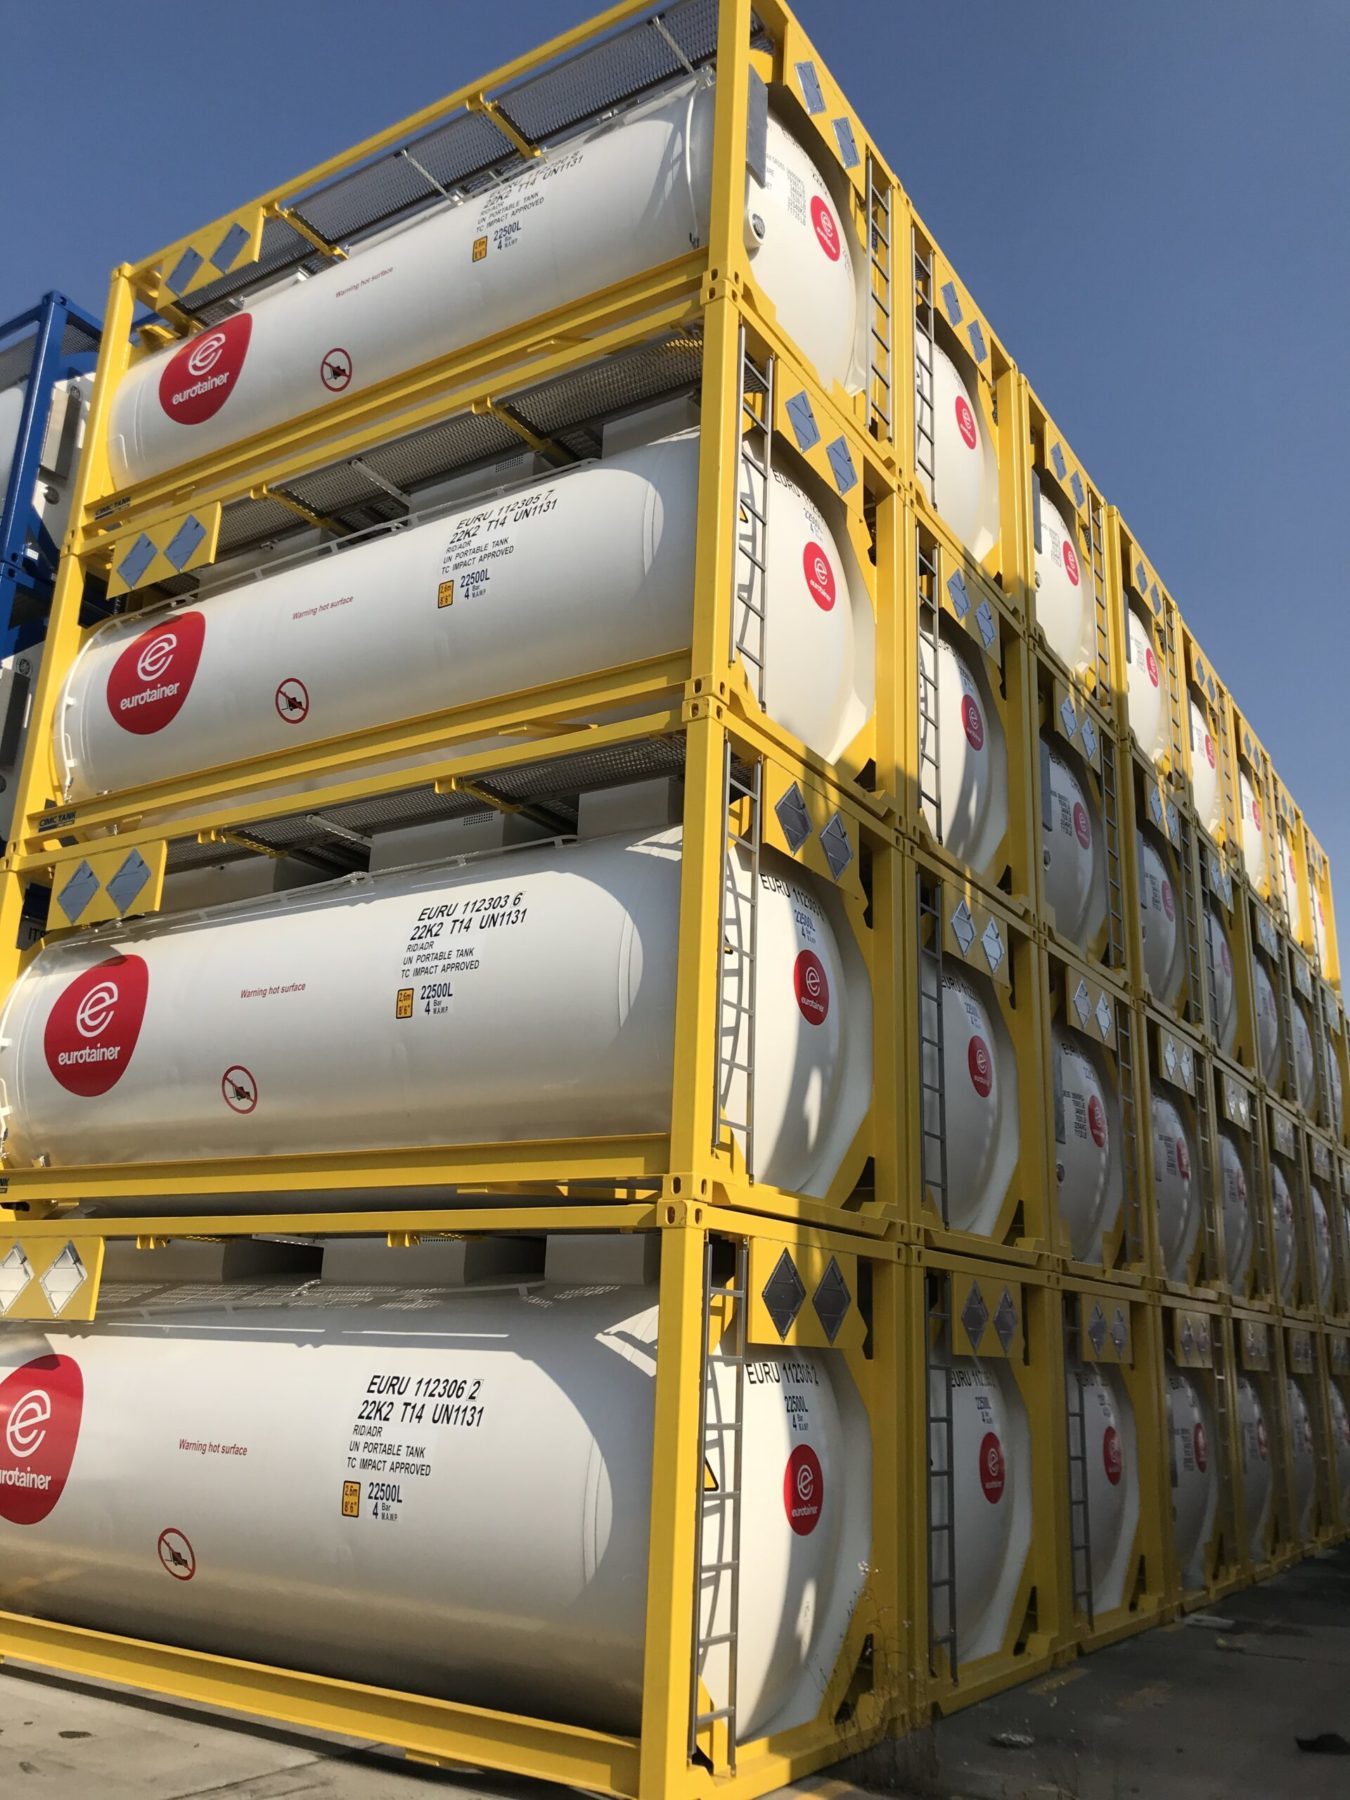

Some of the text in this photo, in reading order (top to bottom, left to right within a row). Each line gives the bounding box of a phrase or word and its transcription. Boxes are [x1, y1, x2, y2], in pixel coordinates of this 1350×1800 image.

[477, 197, 544, 233] TC IMPACT APPROVED
[478, 192, 539, 225] UN PORTABLE TANK
[494, 220, 522, 241] 22500L
[497, 240, 502, 250] 4
[336, 266, 394, 298] Warning hot surface
[172, 371, 229, 406] eurotainer
[450, 498, 557, 544] 22K2 T14 UN1131
[456, 510, 494, 530] EURU
[498, 493, 540, 515] 112305
[442, 545, 514, 575] TC IMPACT APPROVED
[443, 537, 509, 564] UN PORTABLE TANK
[460, 568, 490, 588] 22500L
[464, 587, 469, 600] 4
[292, 595, 354, 620] Warning hot surface
[120, 681, 180, 710] eurotainer
[760, 873, 790, 898] EURU
[418, 892, 523, 922] EURU 112303 6
[410, 908, 527, 941] 22K2 T14 UN1131
[403, 948, 474, 966] UN PORTABLE TANK
[406, 941, 434, 953] RID/ADR
[401, 960, 479, 978] TC IMPACT APPROVED
[240, 982, 306, 1000] Warning hot surface
[420, 982, 453, 1000] 22500L
[424, 1000, 430, 1015] 4
[58, 1043, 121, 1066] eurotainer
[745, 1363, 780, 1384] EURU
[367, 1375, 481, 1400] EURU 112306 2
[358, 1400, 484, 1427] 22K2 T14 UN1131
[352, 1425, 383, 1438] RID/ADR
[179, 1438, 248, 1456] Warning hot surface
[349, 1441, 426, 1459] UN PORTABLE TANK
[347, 1457, 431, 1477] TC IMPACT APPROVED
[0, 1467, 51, 1490] rotainer
[368, 1482, 402, 1503] 22500L
[372, 1501, 391, 1520] 4 Bar
[792, 1504, 818, 1517] eurotainer
